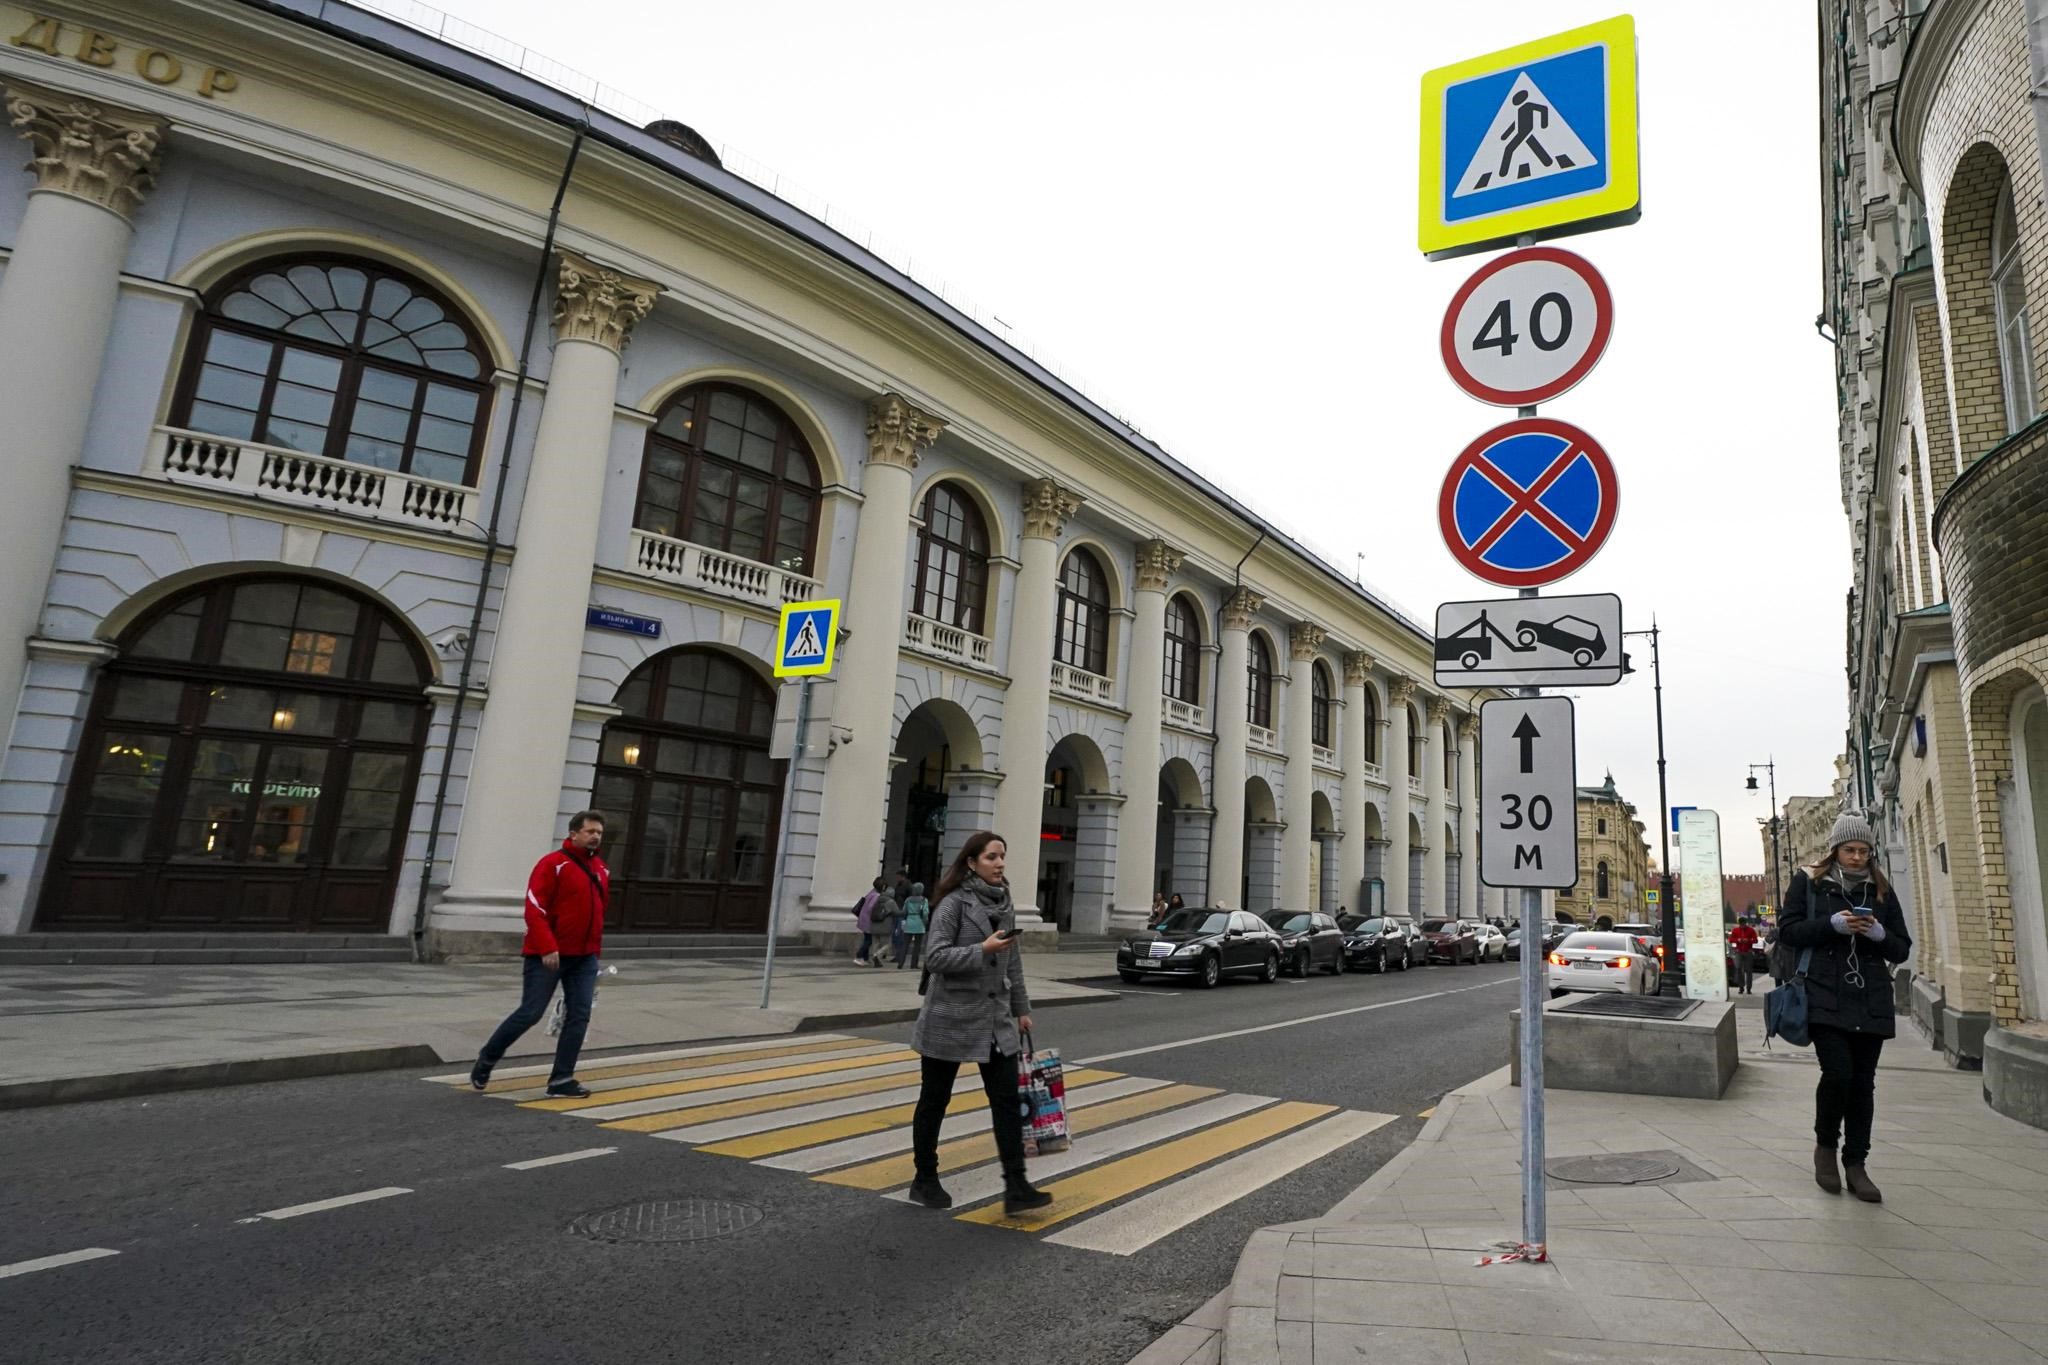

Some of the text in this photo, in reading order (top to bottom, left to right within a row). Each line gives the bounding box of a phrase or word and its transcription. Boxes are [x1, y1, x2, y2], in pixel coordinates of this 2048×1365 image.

[10, 15, 238, 97] ДВОР
[1473, 292, 1573, 356] 40
[648, 623, 657, 633] 4
[1500, 794, 1553, 831] 30
